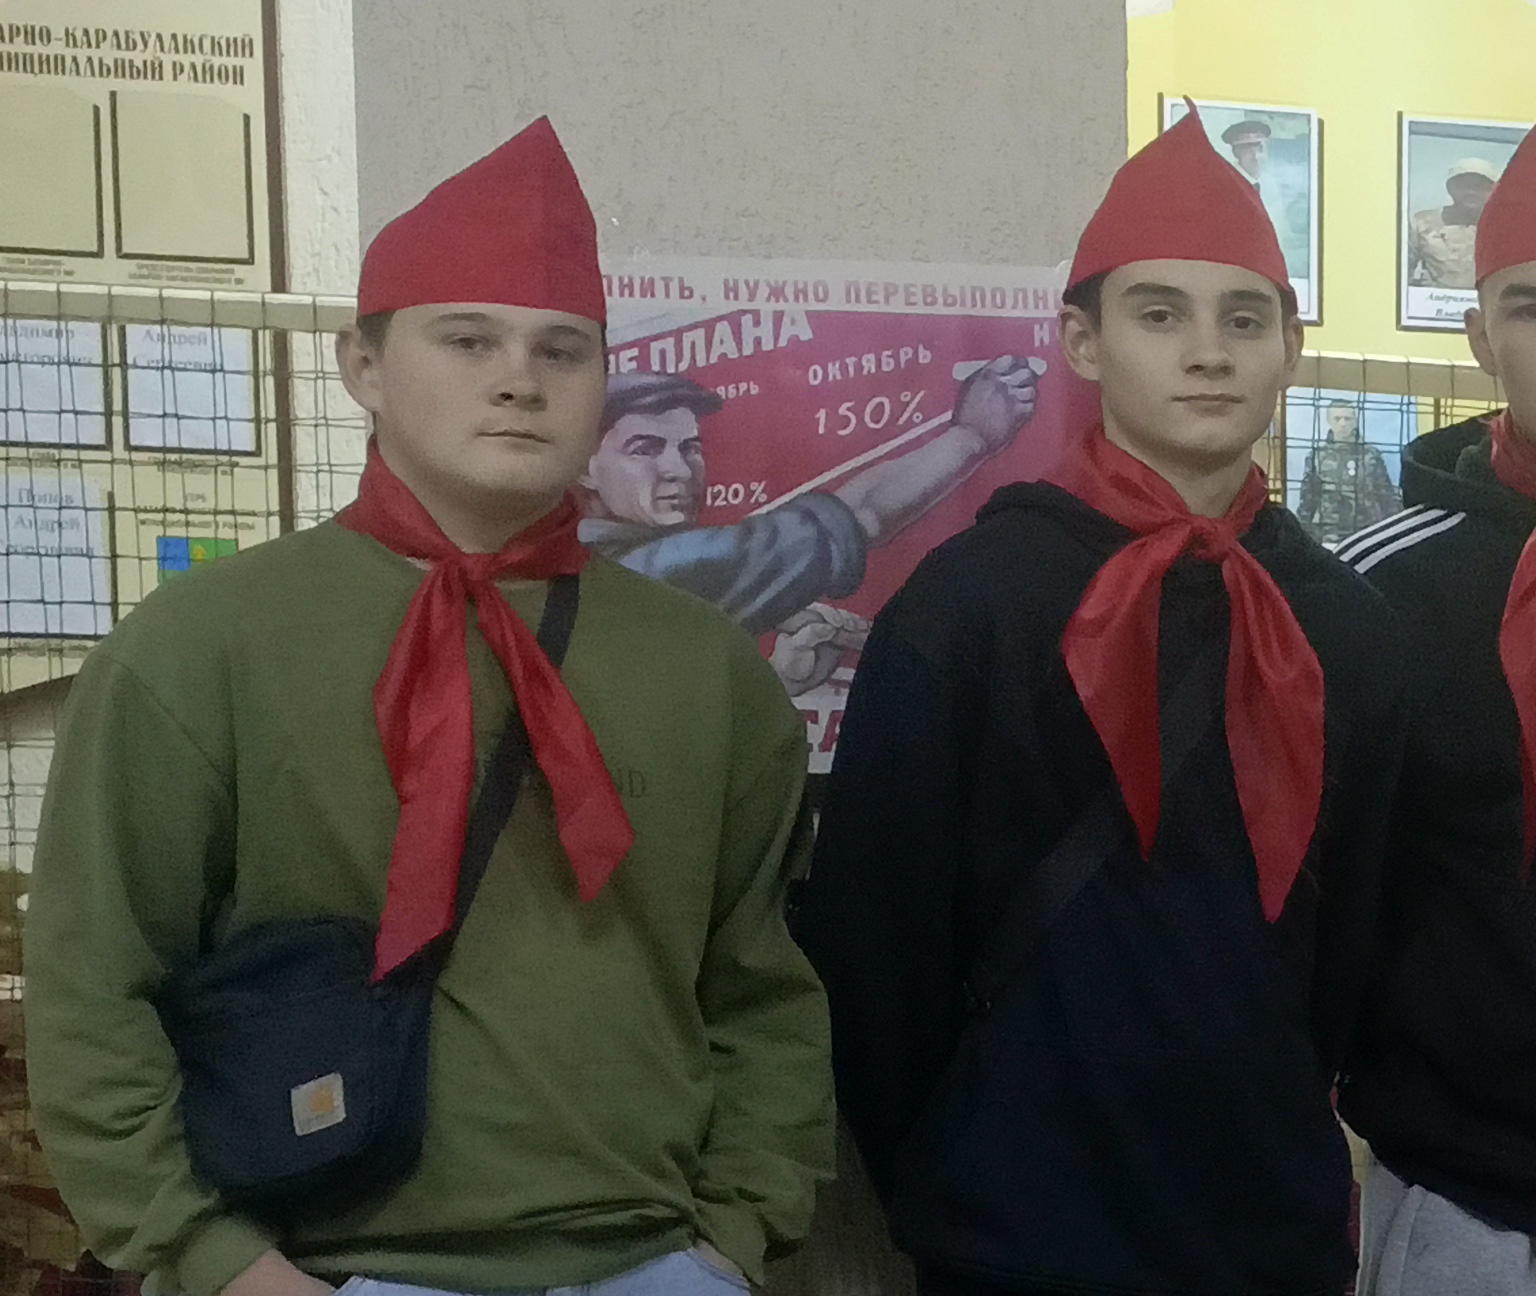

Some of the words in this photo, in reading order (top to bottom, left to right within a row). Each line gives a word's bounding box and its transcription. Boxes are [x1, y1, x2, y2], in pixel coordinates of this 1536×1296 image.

[172, 61, 245, 87] РАЙОН
[722, 277, 829, 304] НУЖНО
[649, 308, 813, 373] ПЛАНА
[808, 345, 932, 386] ОКТЯБРЬ
[710, 380, 759, 400] ЯБРЬ
[815, 390, 927, 437] 150%
[707, 481, 768, 507] 120%
